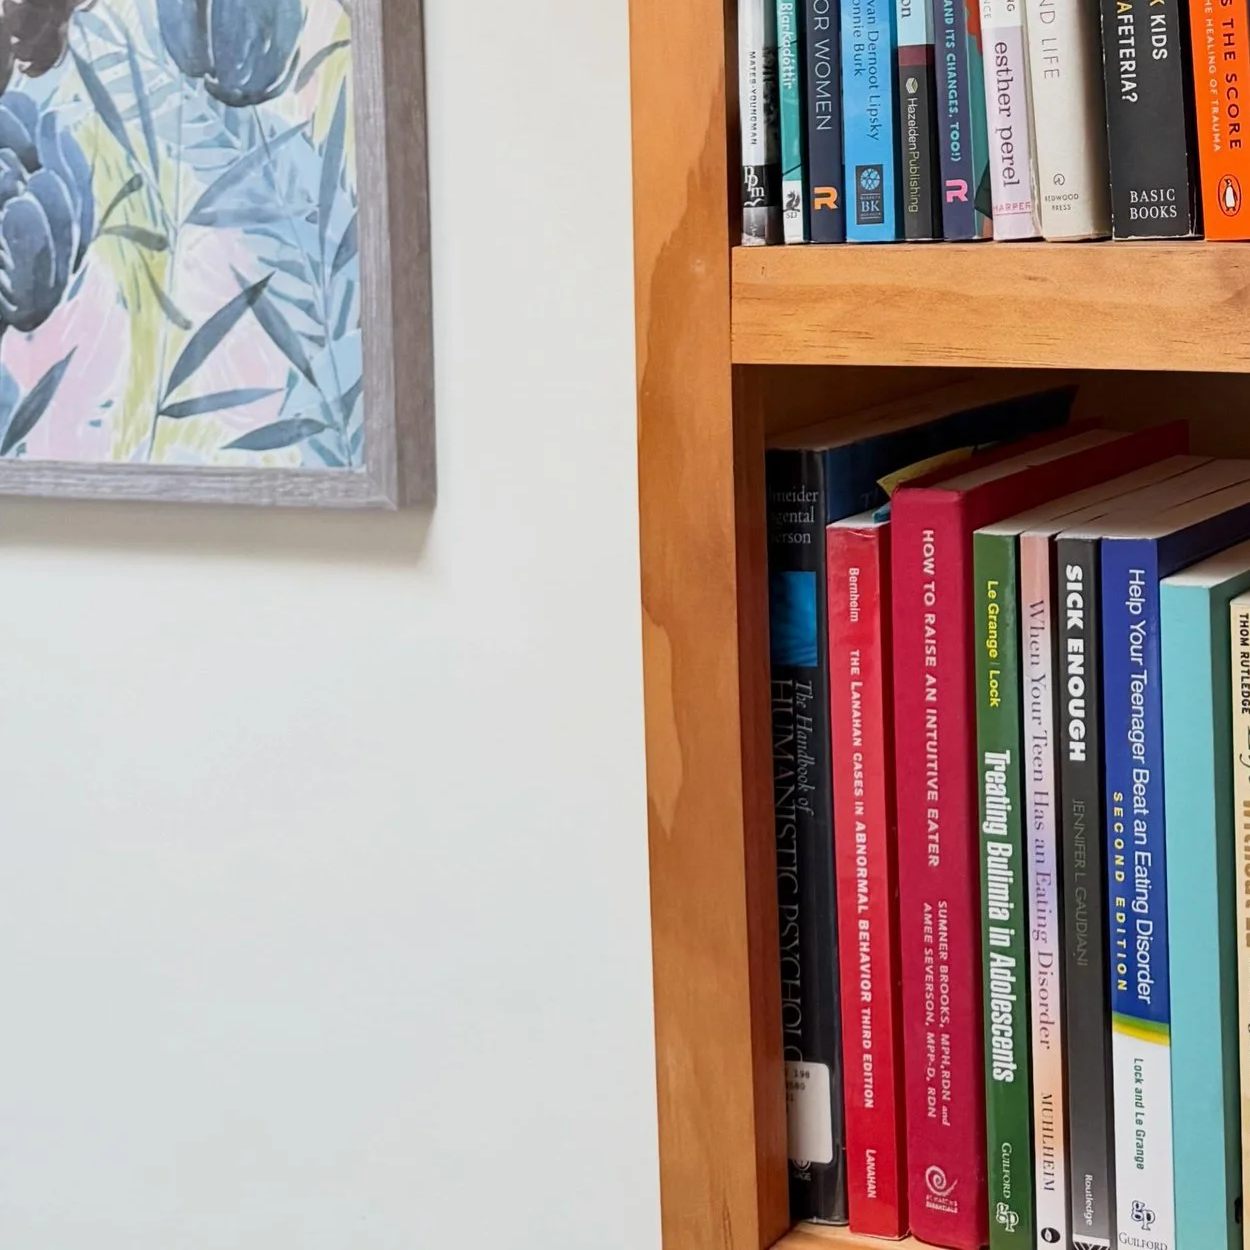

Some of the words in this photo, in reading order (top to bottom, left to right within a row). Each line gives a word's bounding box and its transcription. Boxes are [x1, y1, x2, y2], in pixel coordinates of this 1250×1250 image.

[867, 0, 879, 25] van
[945, 29, 955, 48] ITS
[1151, 14, 1167, 60] KIDS
[867, 30, 880, 90] Dernoot
[946, 53, 959, 118] CHANGES,
[994, 42, 1014, 117] esther
[867, 95, 883, 140] Lipsky
[950, 122, 962, 162] TOO!)
[995, 127, 1020, 187] perel
[1129, 189, 1175, 203] BASIC
[1129, 205, 1177, 219] BOOKS
[849, 568, 860, 622] Bernheim
[1066, 565, 1084, 629] SICK
[1239, 614, 1249, 646] THOM
[1067, 638, 1086, 761] ENOUGH
[1241, 651, 1250, 714] RUTLEDGE
[984, 750, 1010, 836] Treating
[986, 841, 1014, 919] Bulimia
[989, 926, 1015, 947] in
[989, 952, 1016, 1082] Adolescents
[1041, 1092, 1055, 1191] MUHLHEIM
[865, 1149, 877, 1198] LANAHAN
[1083, 1174, 1094, 1225] Routledge
